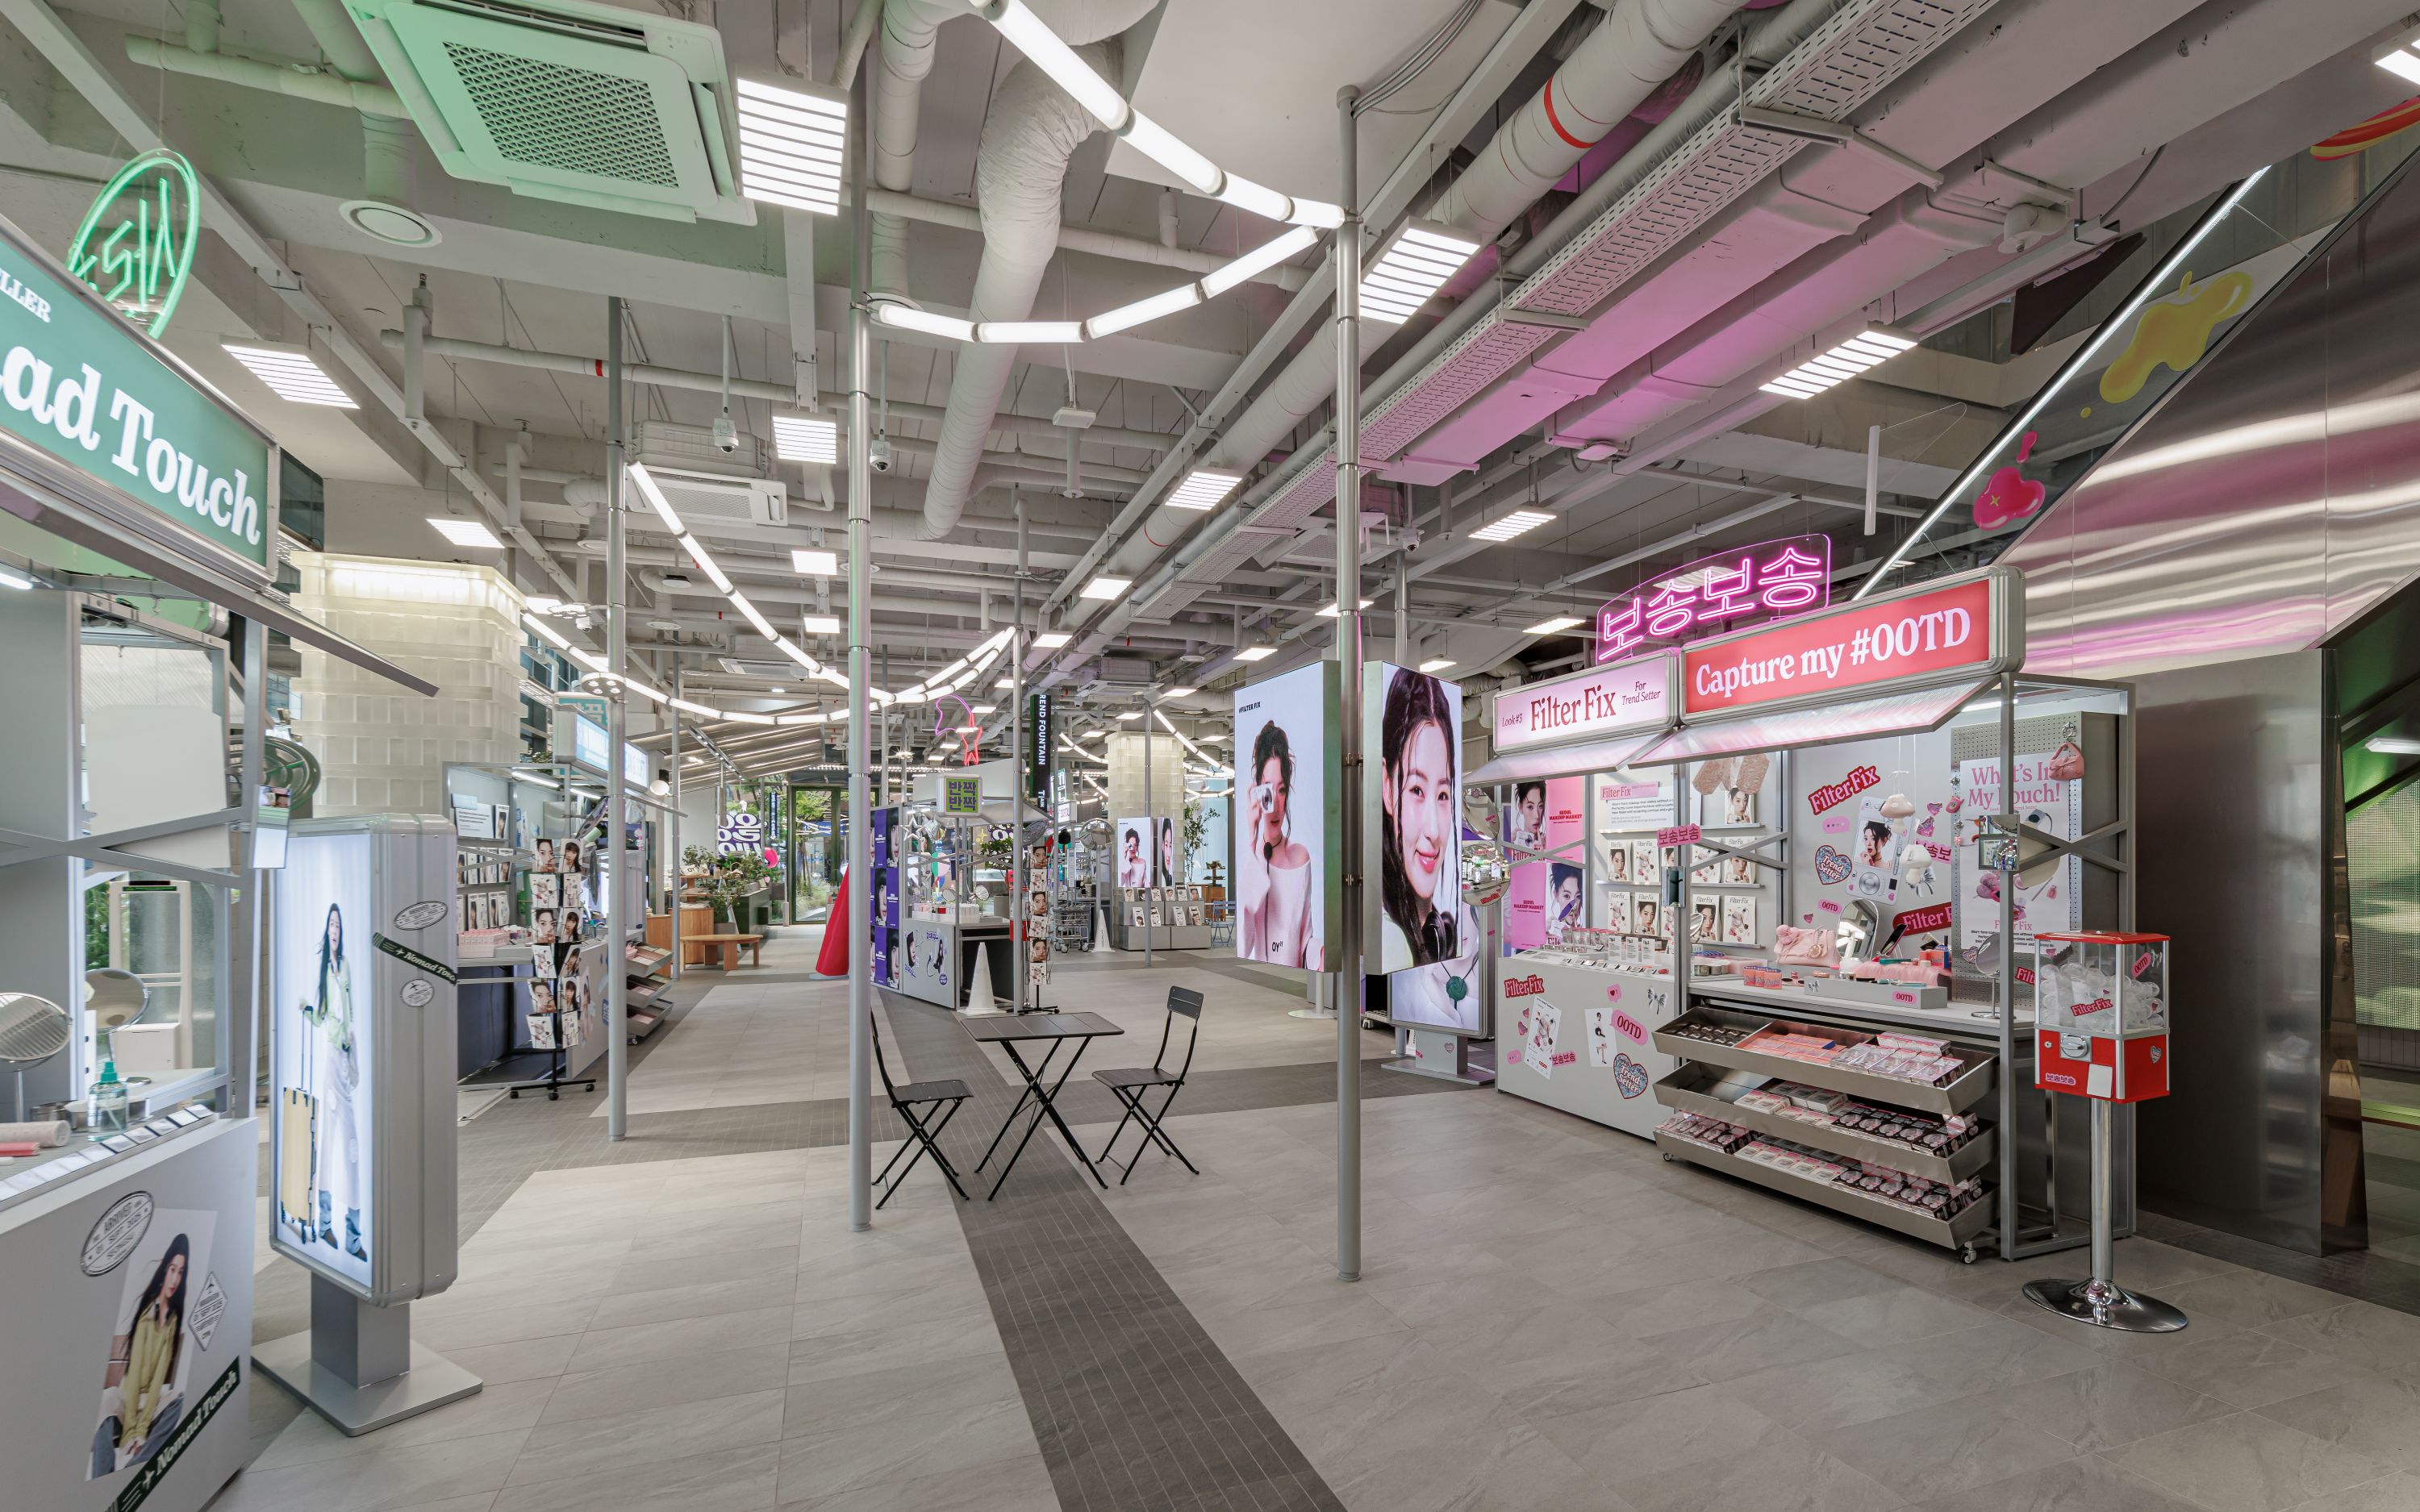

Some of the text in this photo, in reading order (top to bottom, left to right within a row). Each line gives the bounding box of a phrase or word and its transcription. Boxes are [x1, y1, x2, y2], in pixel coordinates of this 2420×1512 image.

[0, 345, 261, 546] ad Touch
[1599, 547, 1822, 660] 보송보송
[1696, 606, 1971, 698] Capture my #OOTD
[1635, 681, 1646, 691] For
[1622, 690, 1661, 705] Trend Setter
[1531, 695, 1581, 731] Filter
[1583, 684, 1617, 721] Fix
[1038, 720, 1046, 765] FOUNTAIN
[1971, 763, 2033, 785] Wht's
[949, 781, 976, 796] 반짝
[1602, 787, 1621, 798] Filter
[1621, 785, 1630, 796] Fix
[949, 796, 976, 810] 반짝
[1967, 788, 1994, 810] My
[1658, 826, 1700, 845] 보송보송
[1818, 862, 1841, 880] Setter
[1823, 855, 1844, 873] Trend
[1821, 901, 1838, 912] OOTD
[403, 952, 437, 972] Nomad
[2134, 956, 2148, 974] OOTD
[1505, 975, 1544, 998] Filter Fix
[1896, 993, 1913, 1002] OOTD
[2072, 1002, 2097, 1016] Filter
[1617, 1015, 1642, 1039] OOTD
[1552, 1052, 1575, 1065] 보송보송
[1619, 1073, 1639, 1093] Setter
[1621, 1064, 1641, 1085] Trend
[2047, 1073, 2075, 1085] 보송보송
[156, 1408, 203, 1477] Nomad
[202, 1370, 238, 1420] Touch
